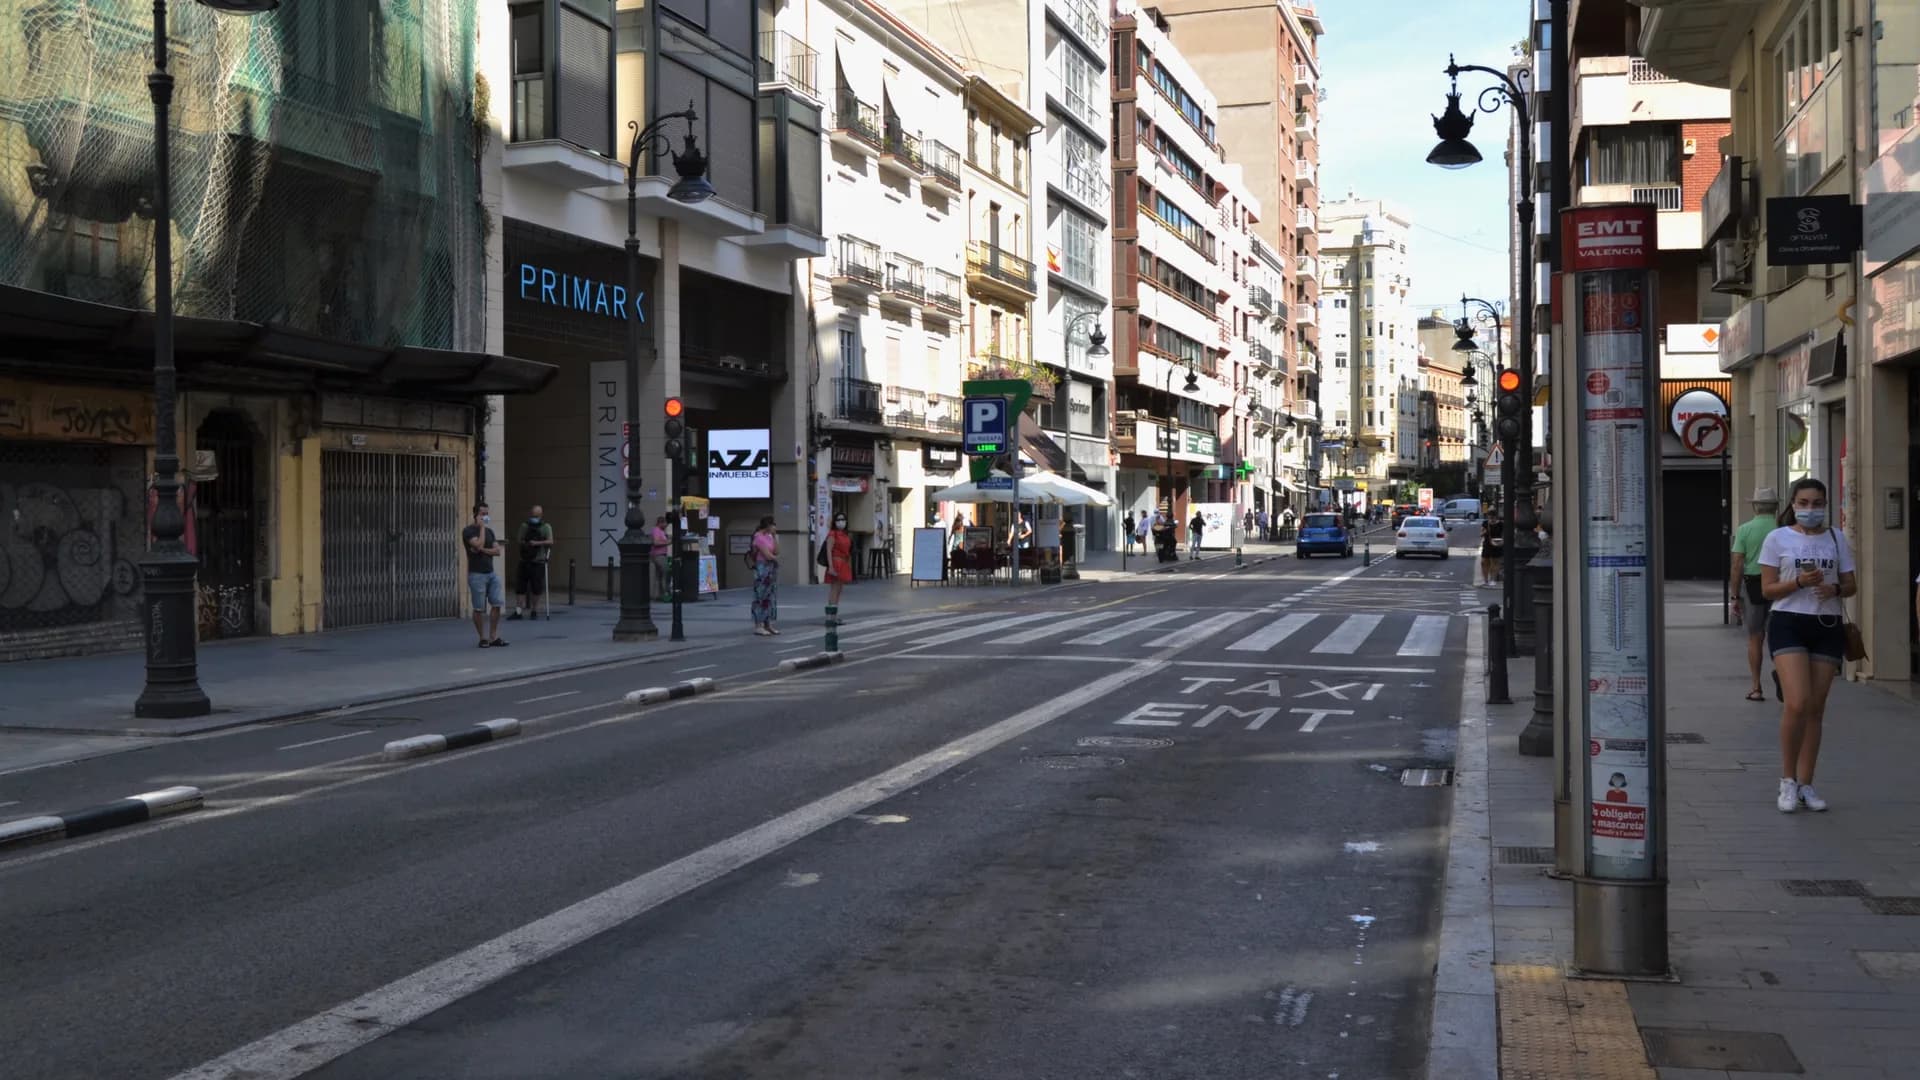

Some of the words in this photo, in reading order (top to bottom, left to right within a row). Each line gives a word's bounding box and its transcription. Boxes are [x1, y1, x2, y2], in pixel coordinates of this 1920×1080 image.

[1578, 220, 1643, 237] EMT
[1578, 247, 1643, 257] VALENCIA
[521, 263, 645, 323] PRIMARK
[971, 402, 998, 433] P
[598, 380, 617, 545] PRIMARK
[709, 449, 769, 471] AZA
[708, 471, 769, 479] INMUEBLES
[1795, 558, 1834, 569] BINS
[1180, 676, 1385, 701] TAXI
[1112, 702, 1355, 733] EMT
[1600, 807, 1645, 821] obligatori
